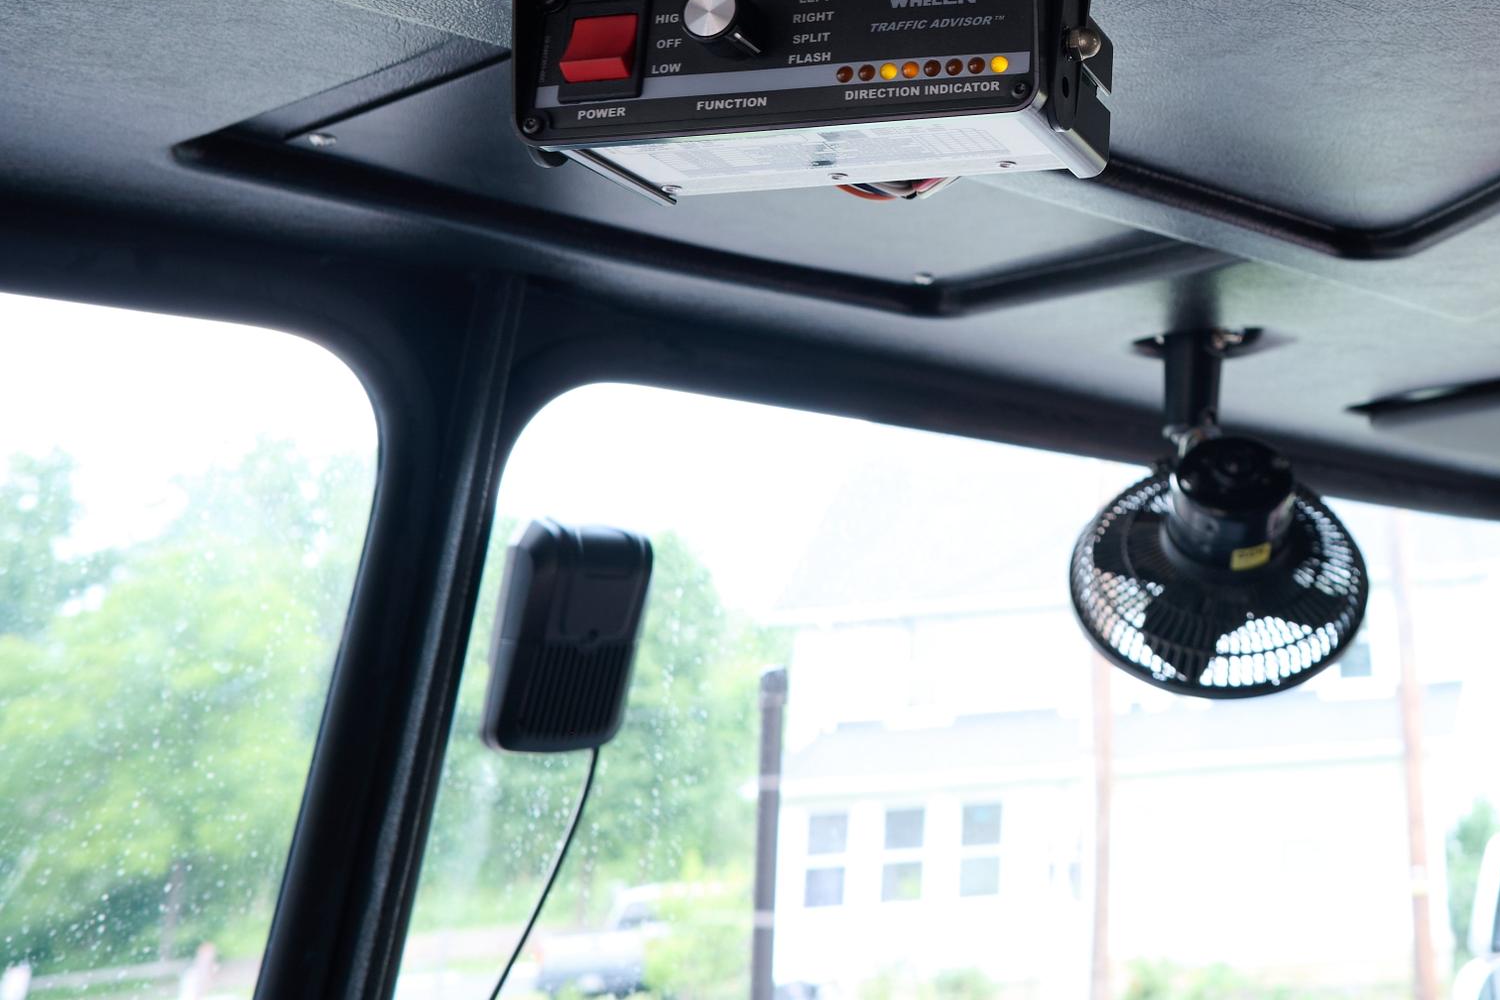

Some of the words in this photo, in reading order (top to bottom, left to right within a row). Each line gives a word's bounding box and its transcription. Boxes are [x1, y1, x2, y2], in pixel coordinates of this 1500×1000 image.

[655, 13, 679, 24] HIG
[792, 11, 835, 24] RIGHT
[870, 19, 928, 33] TRAFFIC
[656, 38, 682, 49] OFF
[792, 32, 831, 44] SPLIT
[788, 52, 832, 65] FLASH
[651, 63, 682, 74] LOW
[844, 85, 920, 100] DIRECTION
[924, 81, 1000, 95] INDICATOR
[696, 97, 767, 111] FUNCTION
[577, 107, 626, 120] POWER
